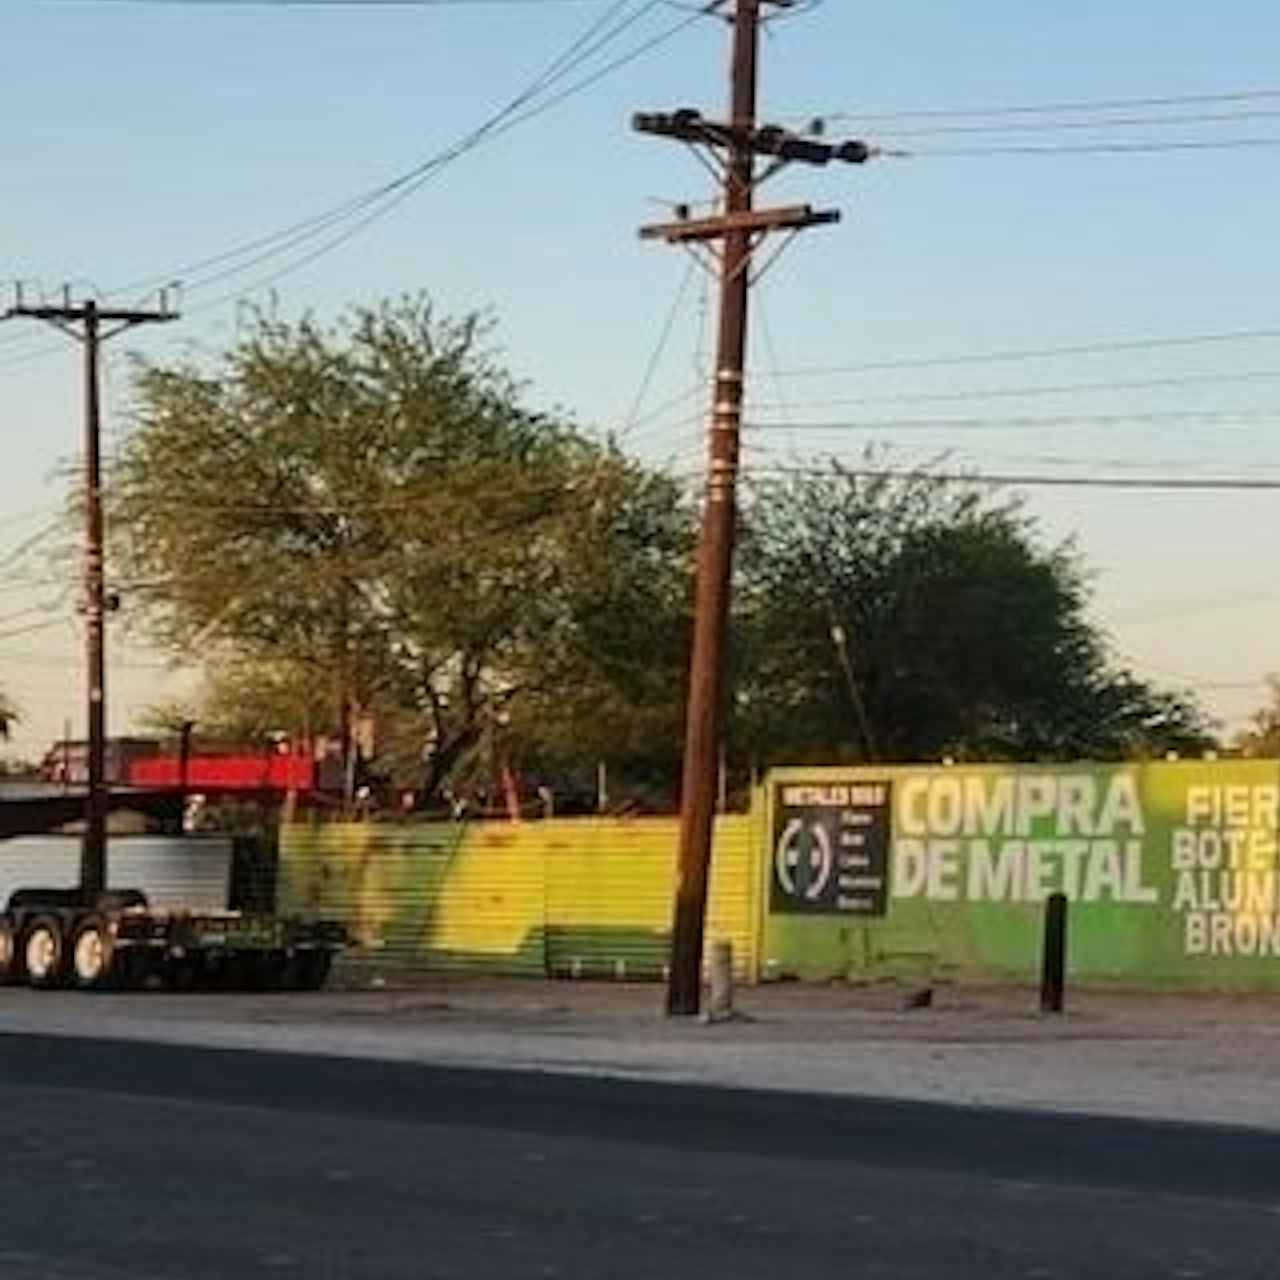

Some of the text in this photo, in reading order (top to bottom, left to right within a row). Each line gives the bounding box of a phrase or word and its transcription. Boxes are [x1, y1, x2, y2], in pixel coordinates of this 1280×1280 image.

[901, 772, 1146, 835] COMPRA
[892, 837, 1158, 902] DE METAL
